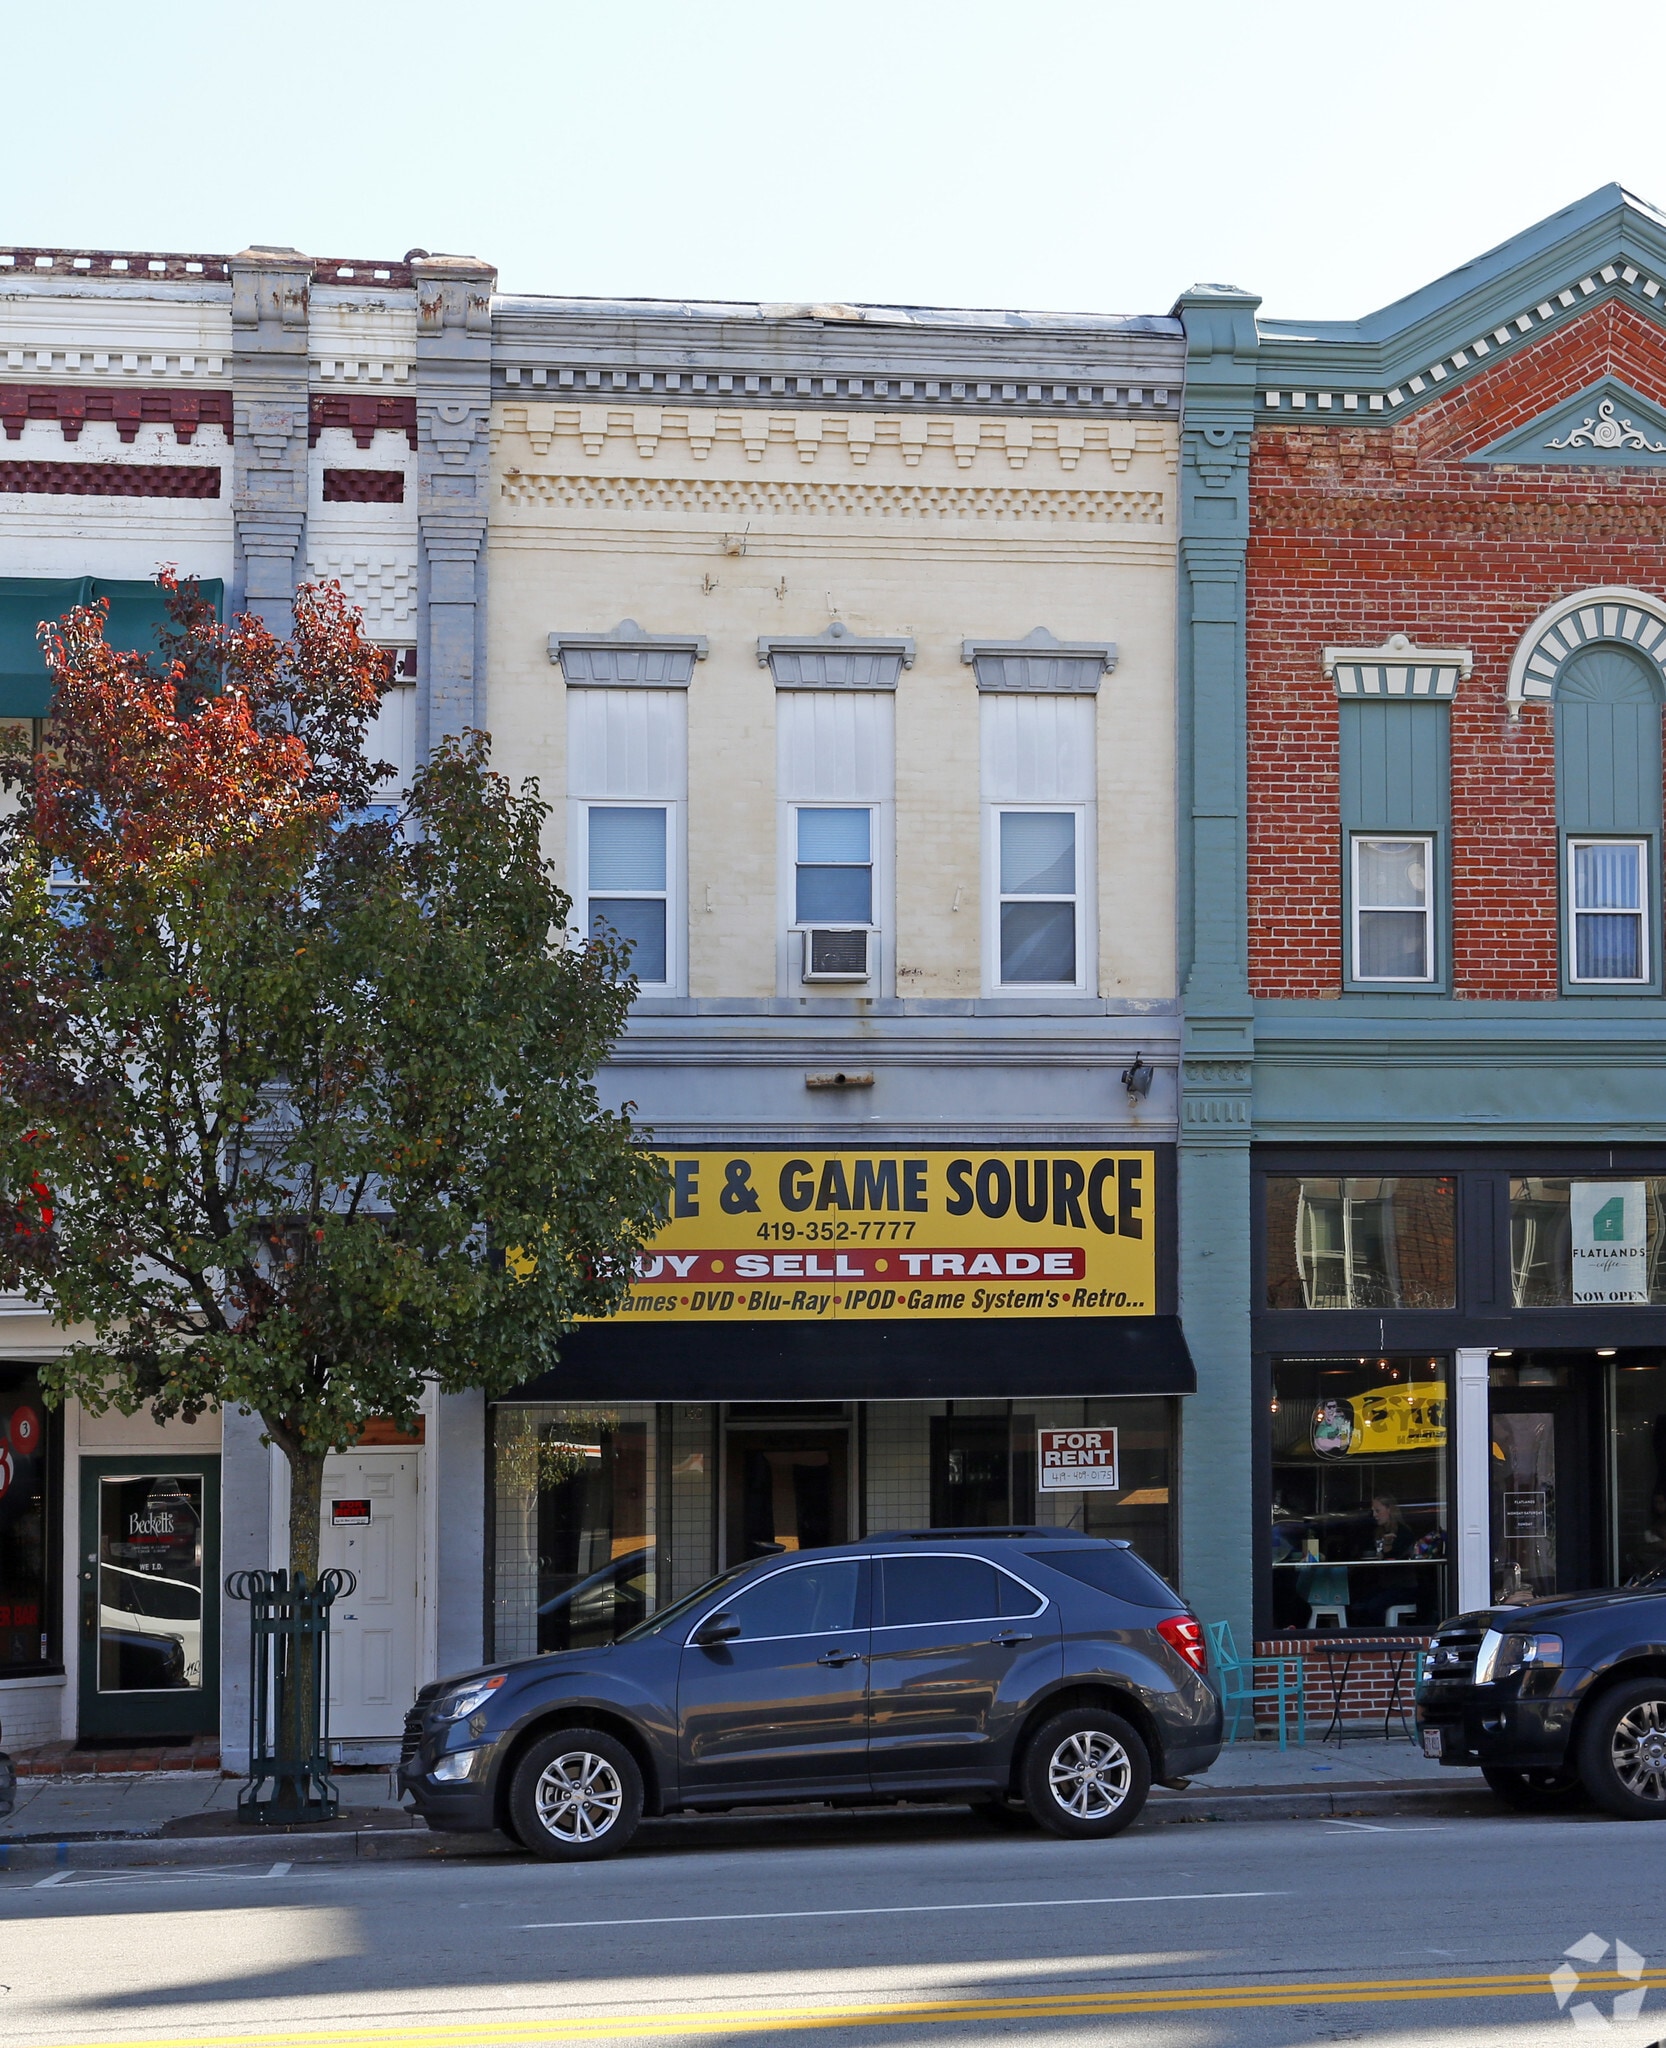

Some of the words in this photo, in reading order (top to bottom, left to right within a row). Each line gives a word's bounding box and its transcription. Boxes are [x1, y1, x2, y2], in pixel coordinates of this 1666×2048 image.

[720, 1159, 761, 1215] &
[779, 1159, 928, 1213] GAME
[946, 1158, 1143, 1240] SOURCE
[756, 1221, 916, 1241] 419-352-7777
[1573, 1248, 1646, 1258] FLATLANDS
[735, 1254, 865, 1277] SELL
[899, 1253, 1074, 1276] TRADE
[1596, 1260, 1619, 1272] coffee
[614, 1295, 677, 1312] ames
[690, 1290, 735, 1312] DVD
[747, 1290, 832, 1315] Blu-Ray
[844, 1289, 896, 1310] IPOD
[907, 1289, 966, 1309] Game
[971, 1288, 1060, 1312] System's
[1071, 1287, 1145, 1308] Retro...
[1573, 1291, 1606, 1302] NOW
[1608, 1291, 1648, 1302] OPEN
[1052, 1433, 1102, 1449] FOR
[1045, 1449, 1110, 1466] RENT
[335, 1508, 368, 1516] RENT
[139, 1563, 150, 1571] WE
